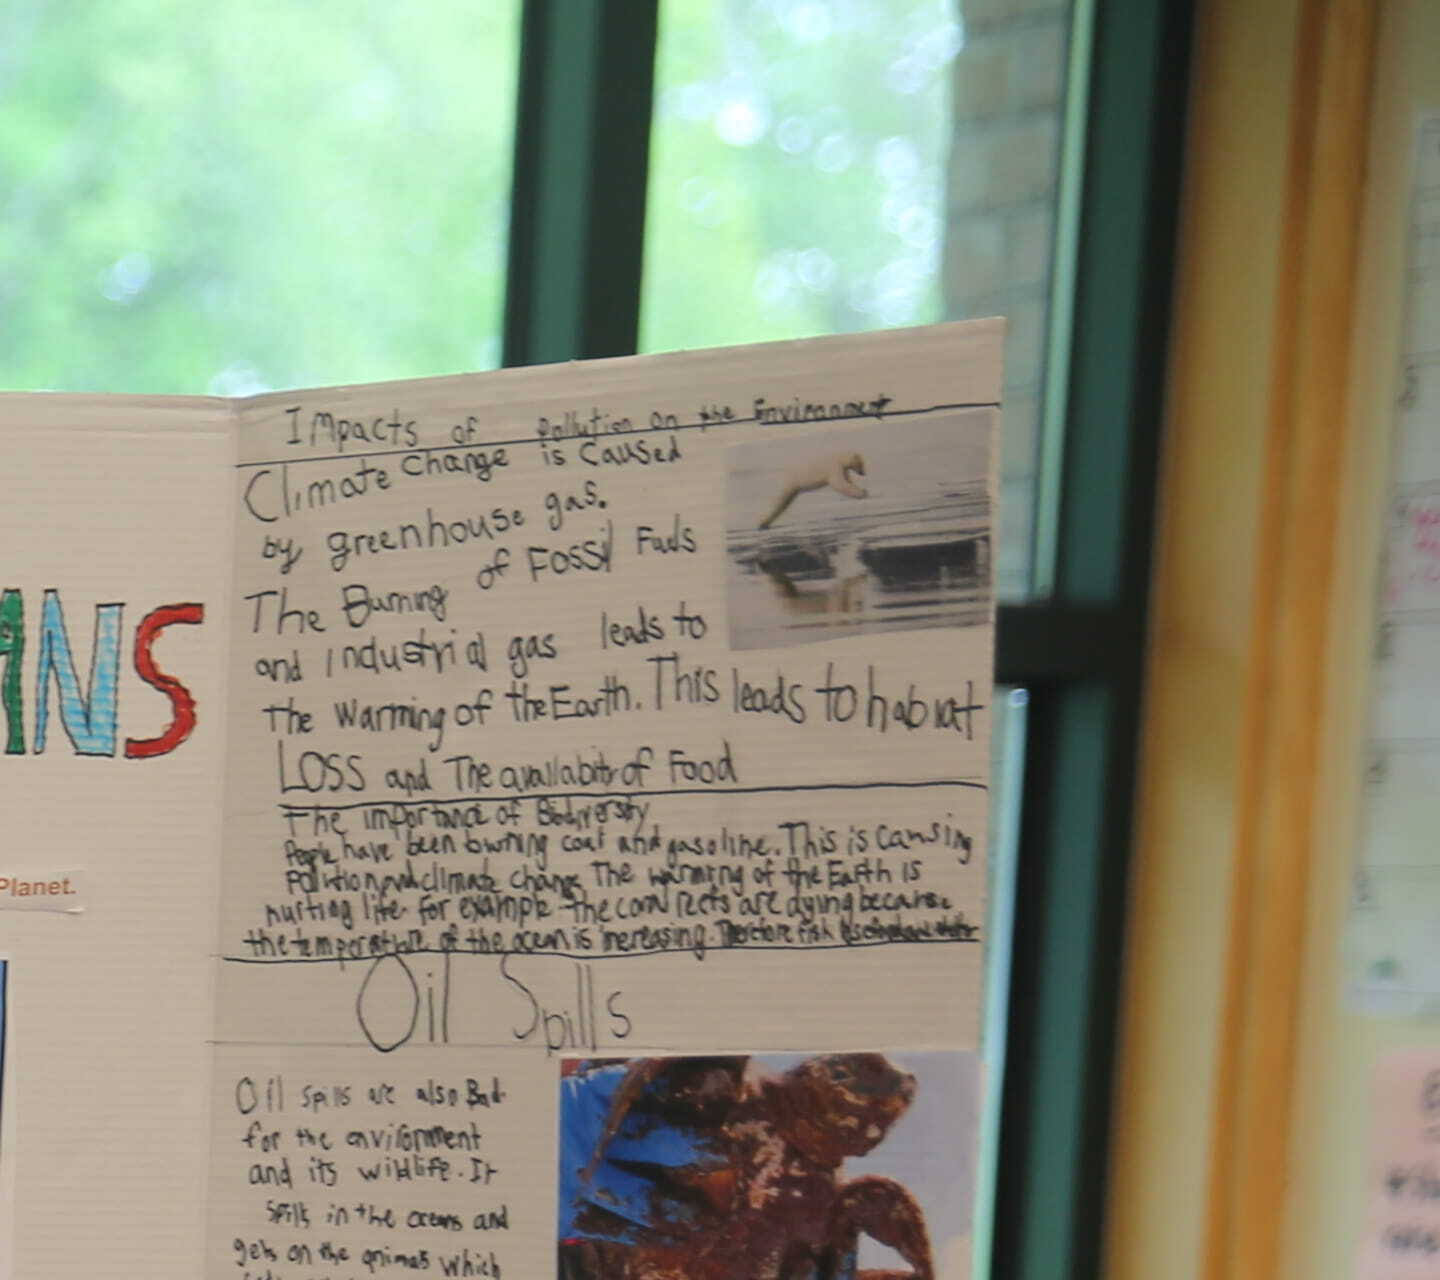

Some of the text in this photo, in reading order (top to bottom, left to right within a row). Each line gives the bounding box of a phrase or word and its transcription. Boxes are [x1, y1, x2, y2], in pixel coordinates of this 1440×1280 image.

[452, 409, 479, 445] of
[544, 441, 566, 466] is
[262, 487, 607, 574] by greenhouse gas.
[356, 952, 633, 1056] Oil Spills
